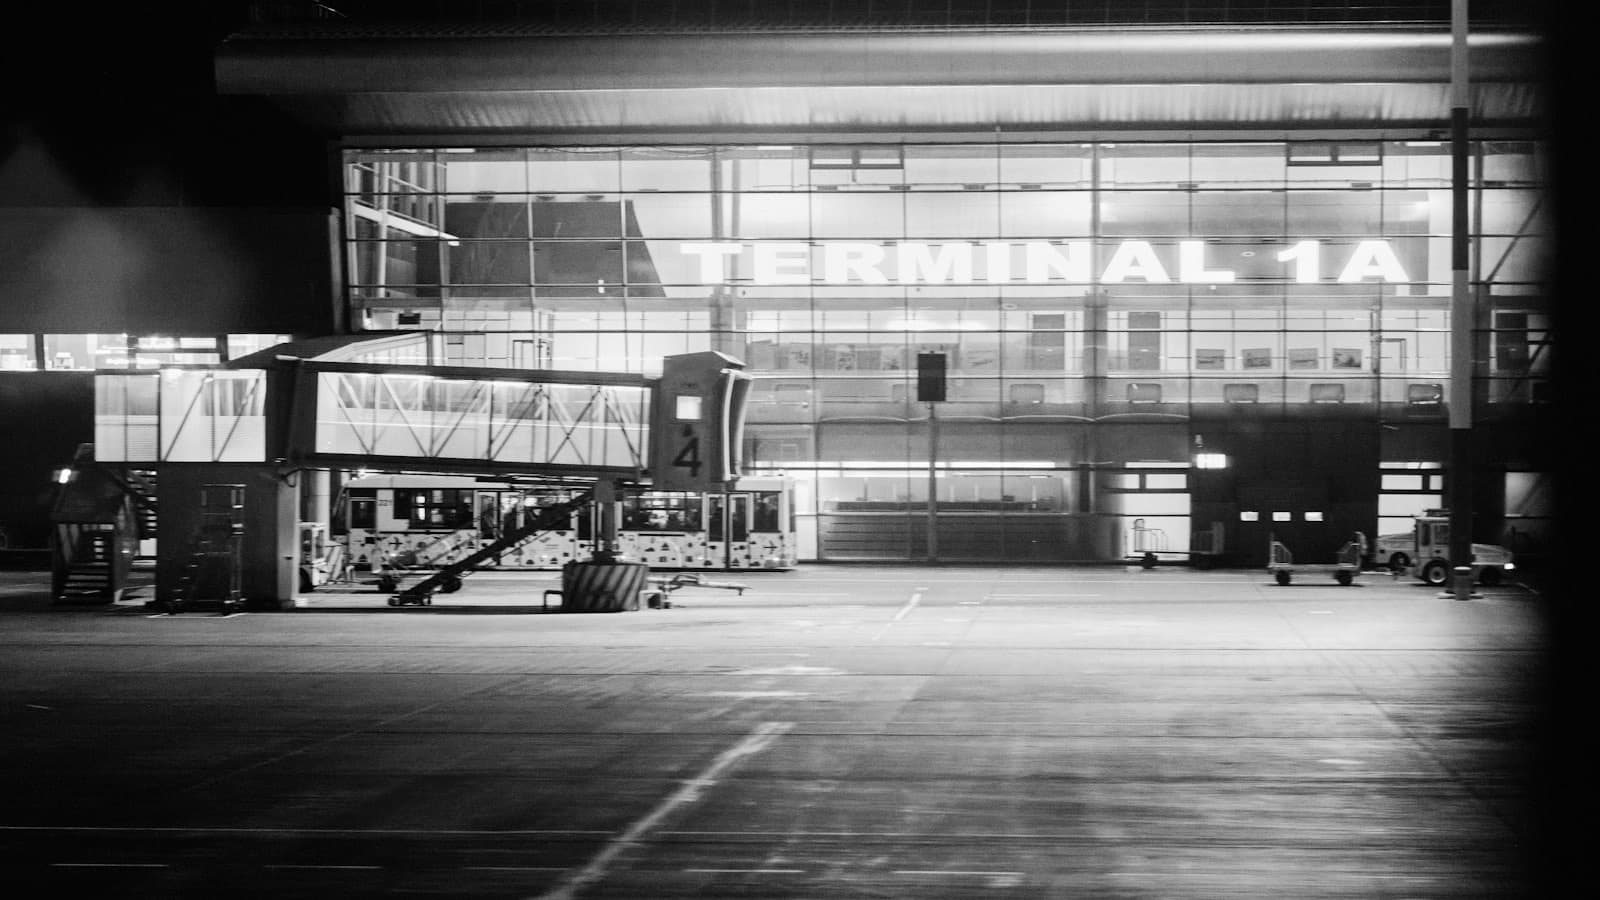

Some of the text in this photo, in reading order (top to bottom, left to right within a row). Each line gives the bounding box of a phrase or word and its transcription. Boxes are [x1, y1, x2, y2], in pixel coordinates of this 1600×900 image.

[681, 240, 1409, 284] TERMINAL 1A
[672, 436, 702, 477] 4
